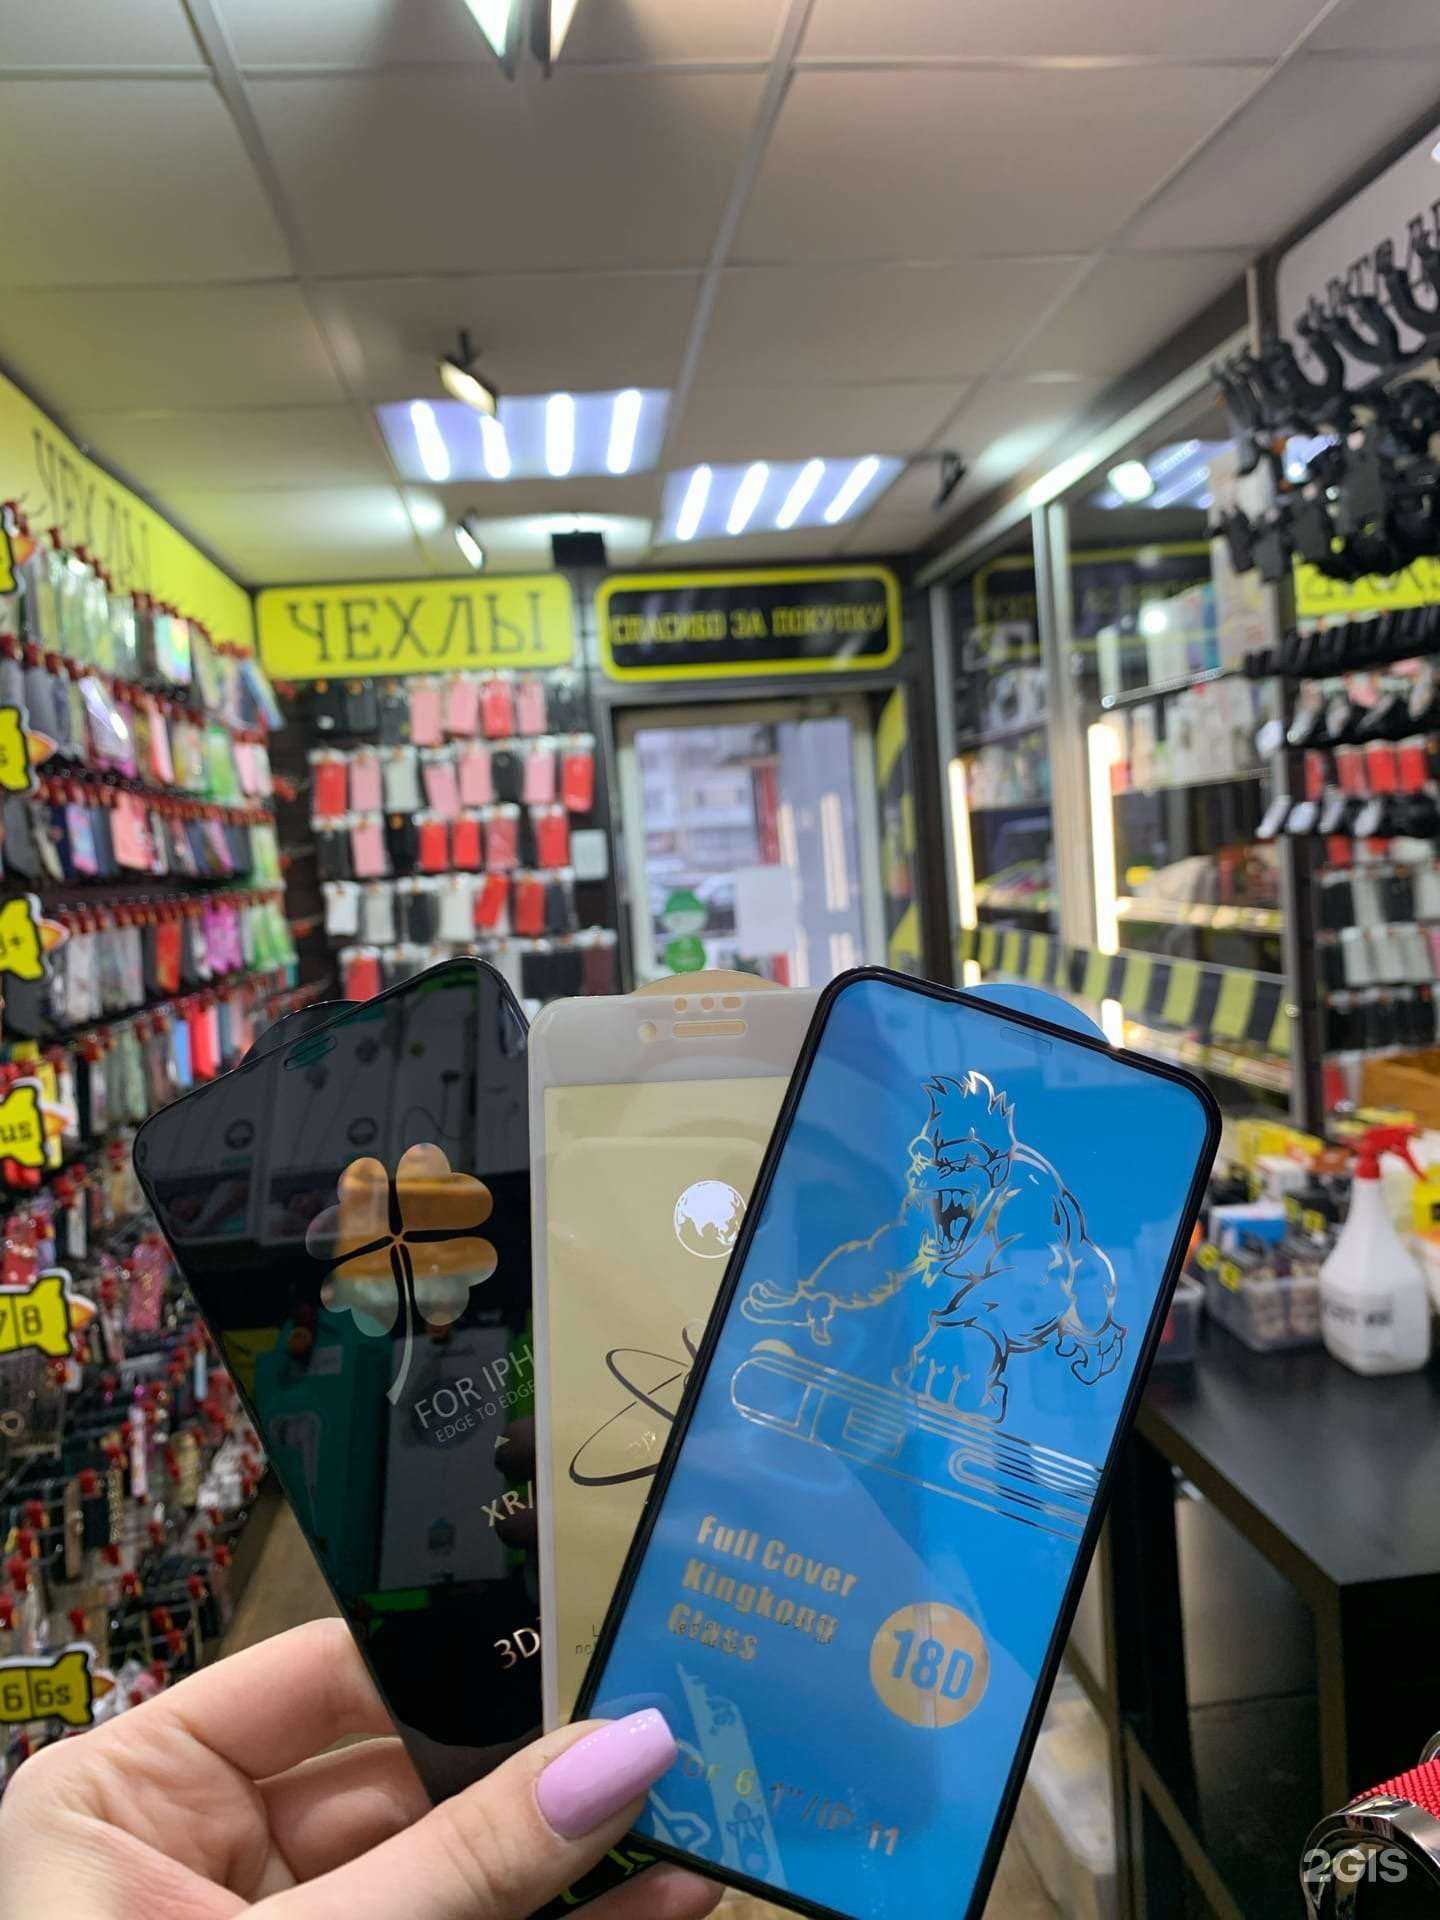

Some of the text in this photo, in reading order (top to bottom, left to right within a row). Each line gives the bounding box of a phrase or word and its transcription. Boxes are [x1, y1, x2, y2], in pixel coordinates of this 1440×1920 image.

[285, 590, 545, 663] ЧЕХЛЫ
[731, 608, 768, 639] ЗА
[23, 1304, 43, 1336] 8
[414, 1377, 482, 1429] FOR
[435, 1414, 476, 1443] EDGE
[475, 1402, 497, 1421] TO
[698, 1513, 858, 1598] Full Cover
[682, 1558, 840, 1645] Kingkong
[493, 1627, 541, 1670] 3D
[667, 1602, 759, 1662] Glass
[889, 1629, 976, 1701] 18D
